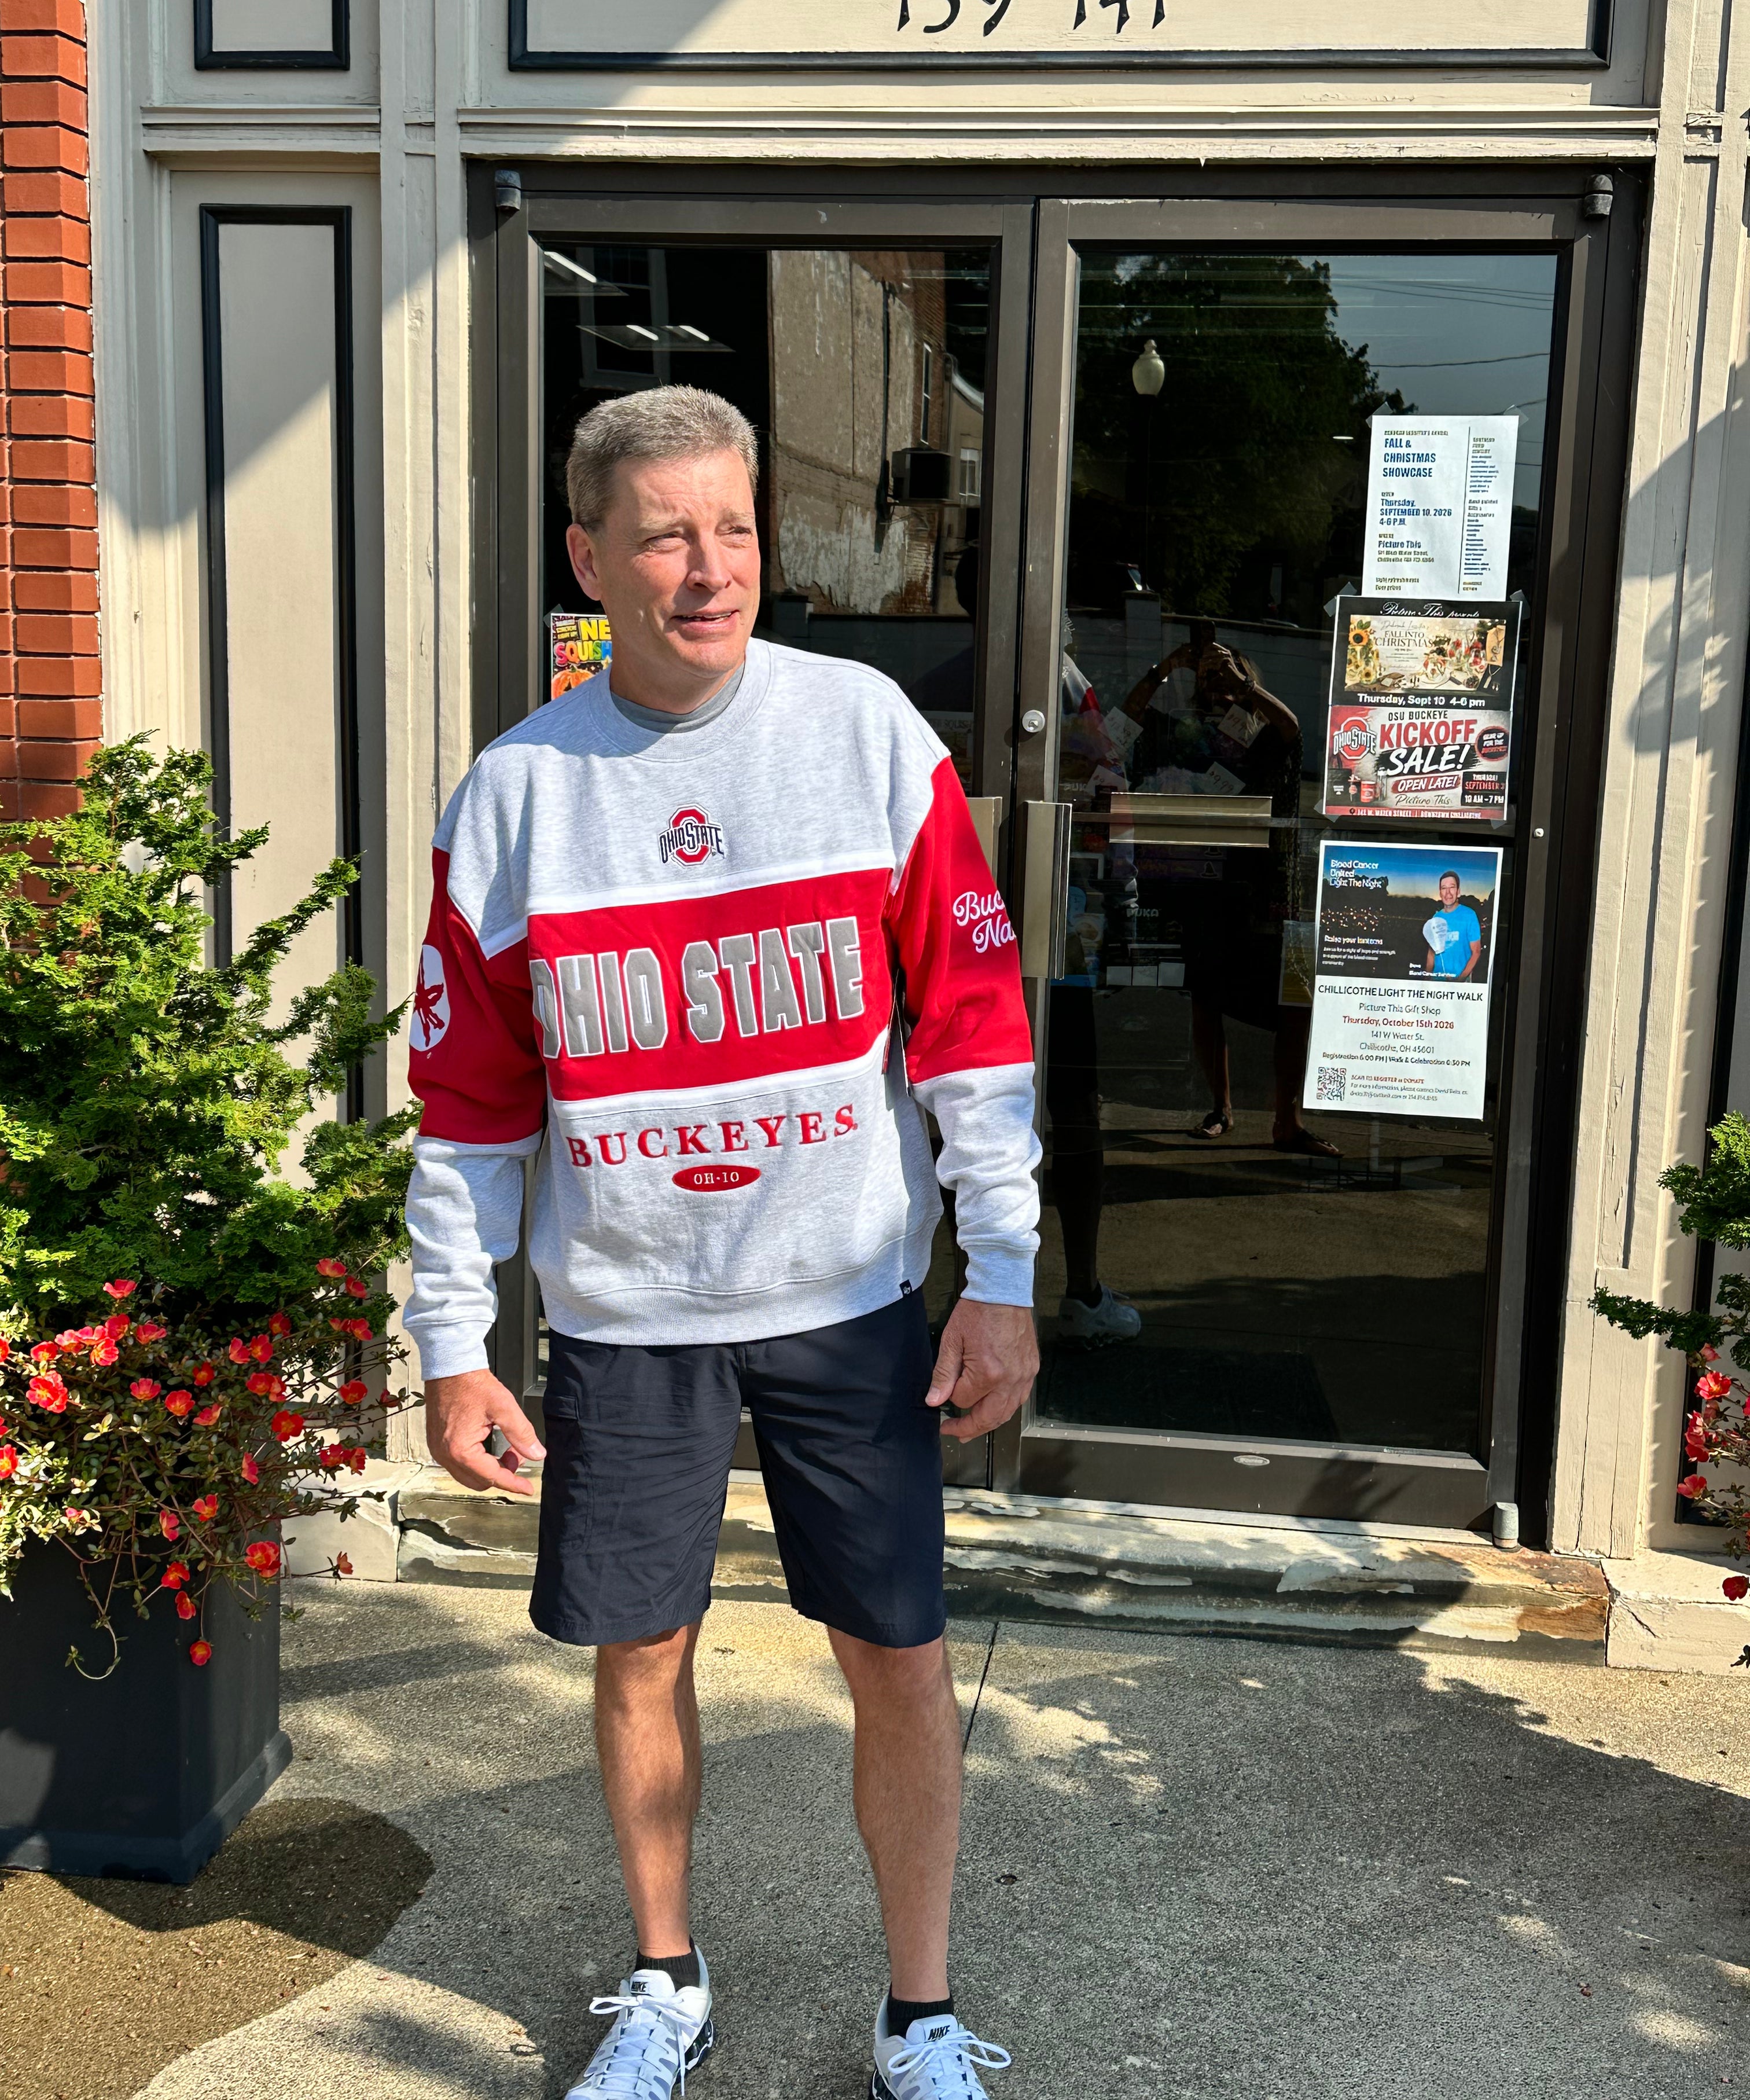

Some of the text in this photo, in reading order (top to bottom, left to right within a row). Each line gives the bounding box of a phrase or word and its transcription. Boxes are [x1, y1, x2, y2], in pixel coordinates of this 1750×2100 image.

[1384, 438, 1411, 448] FALL &
[1384, 453, 1436, 463] CHRISTMAS
[1383, 467, 1433, 478] SHOWCASE
[1418, 603, 1444, 616] This
[1374, 637, 1433, 648] CHRISTMAS
[1357, 693, 1406, 706] Thursday,
[1433, 696, 1445, 705] 10
[1469, 699, 1486, 708] pm
[1388, 710, 1448, 721] OSU BUCKEYE
[1379, 719, 1477, 750] KICKOFF
[1387, 744, 1471, 776] SALE!
[1398, 776, 1458, 792] OPEN LATE!
[1433, 795, 1451, 806] This
[529, 916, 865, 1059] OHIO STATE
[1318, 985, 1483, 1001] CHILLICOTHE LIGHT THE NIGHT WALK
[1359, 1003, 1386, 1012] Picture
[1421, 1005, 1441, 1016] Shop
[1343, 1015, 1381, 1026] Thursday,
[1382, 1018, 1414, 1027] October
[1416, 1019, 1433, 1028] 15th
[565, 1103, 858, 1168] BUCKEYES
[927, 2025, 951, 2041] NIKE
